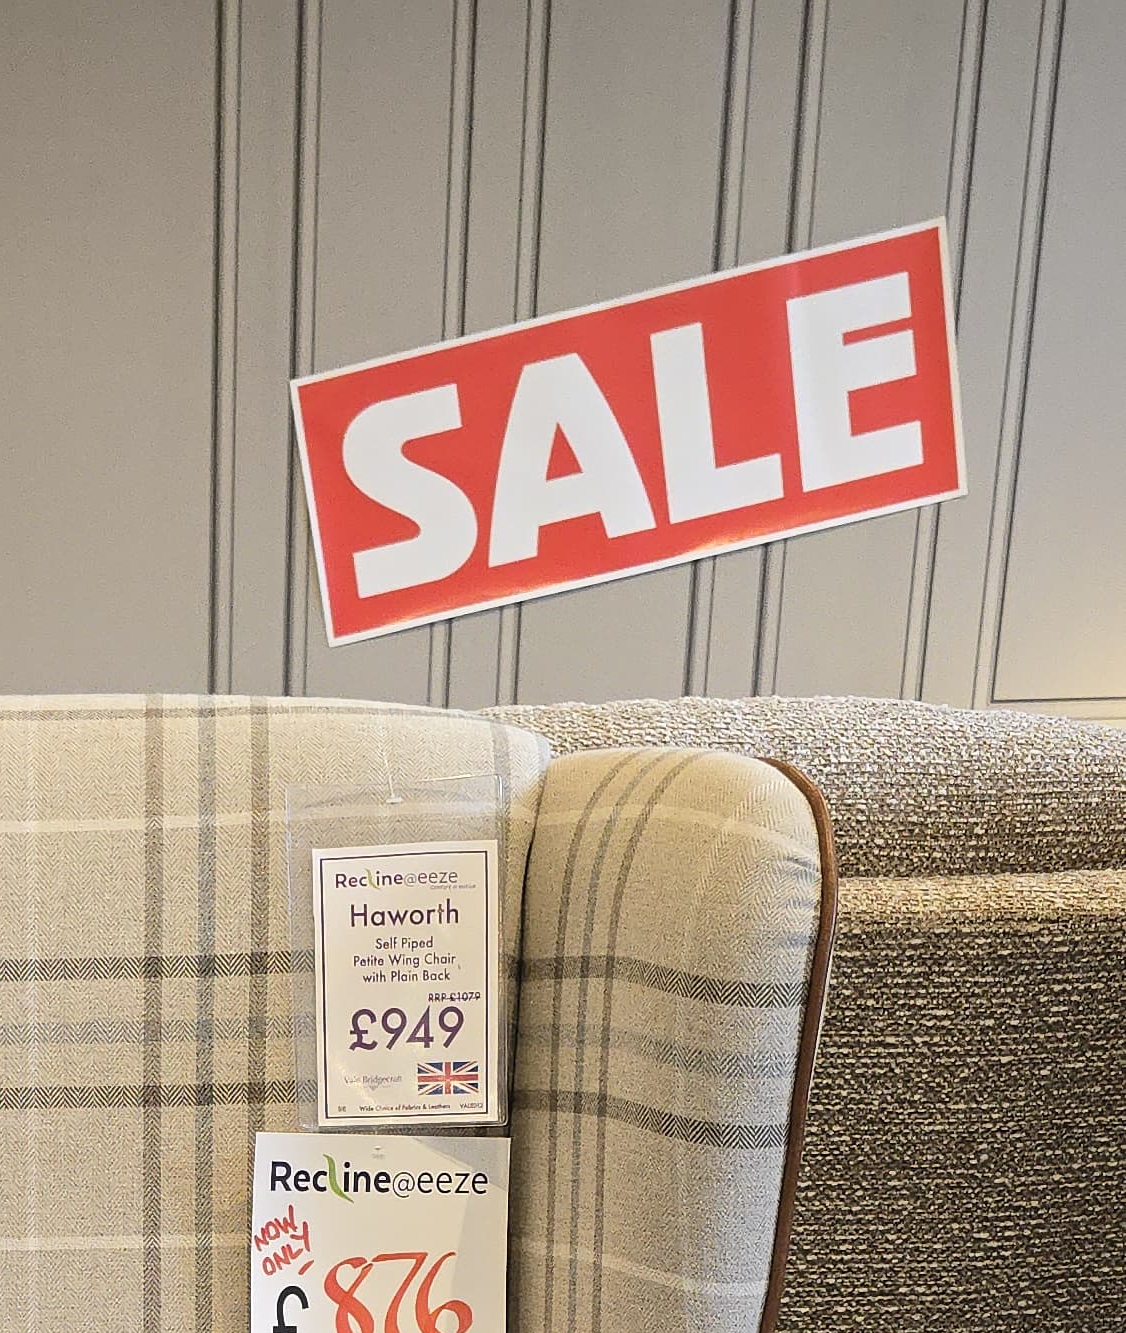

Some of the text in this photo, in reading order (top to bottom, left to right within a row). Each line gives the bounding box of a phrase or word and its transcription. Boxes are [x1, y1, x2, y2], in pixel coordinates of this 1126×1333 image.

[342, 271, 924, 599] SALE
[350, 898, 459, 927] Haworth
[375, 936, 433, 952] Self Piped
[353, 952, 456, 968] Petite Wing Chair
[363, 968, 450, 983] with Plain Back
[428, 993, 447, 1002] RRP
[349, 1005, 464, 1051] £949
[254, 1204, 298, 1252] NOW
[262, 1221, 311, 1276] ONLY
